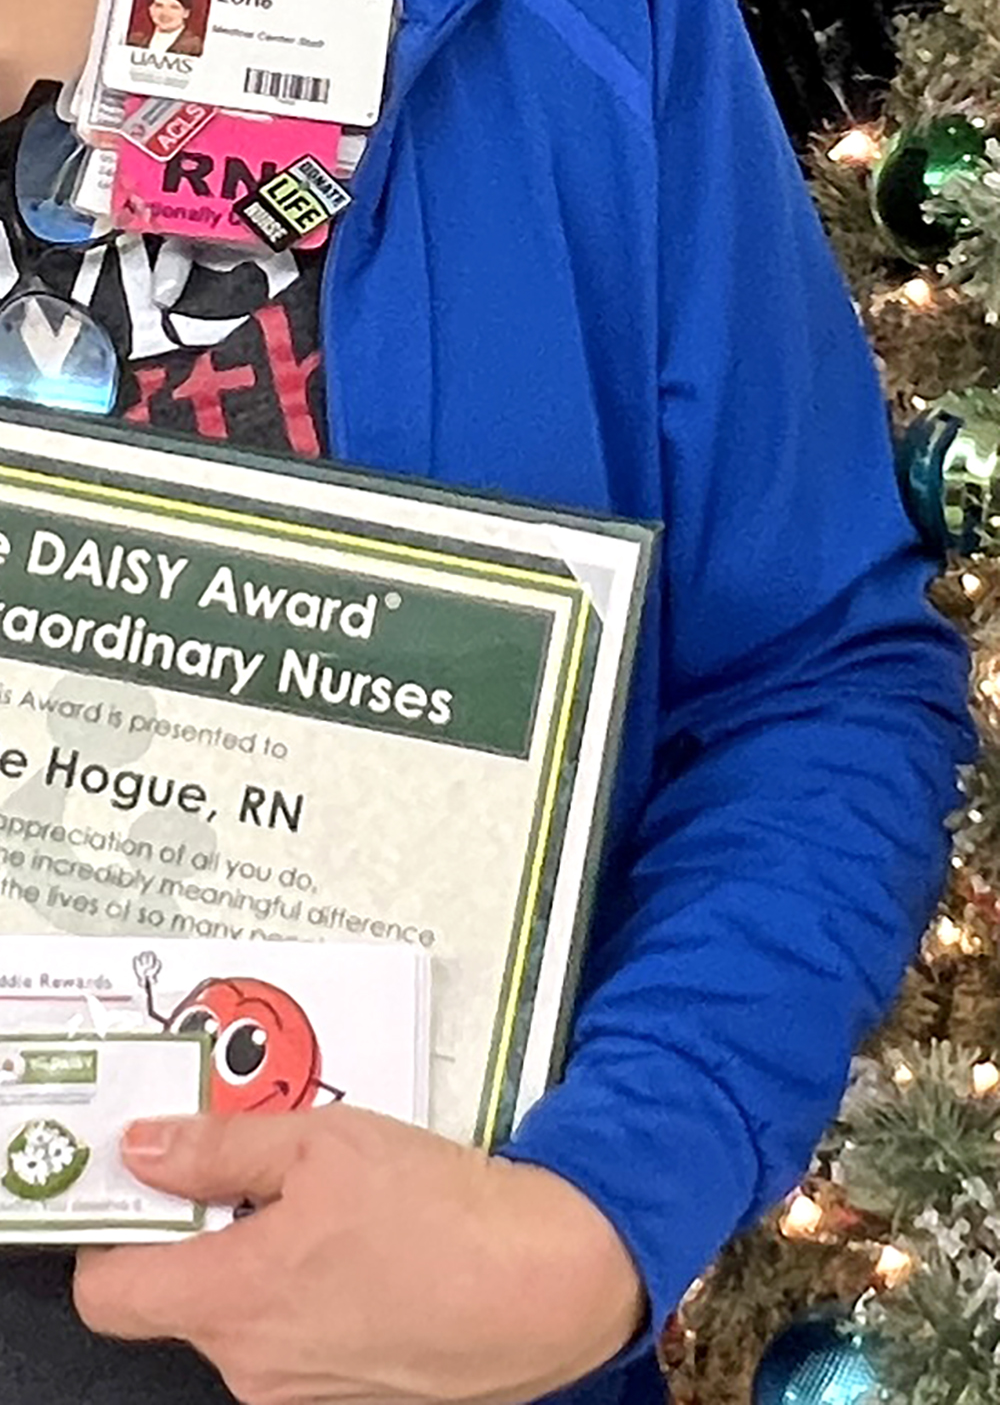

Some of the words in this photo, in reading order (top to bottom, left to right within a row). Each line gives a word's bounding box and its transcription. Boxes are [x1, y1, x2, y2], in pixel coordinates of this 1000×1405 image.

[130, 51, 194, 74] UAMS
[157, 103, 206, 152] ACLS
[162, 151, 278, 200] RN
[266, 177, 322, 230] LIFE
[26, 530, 188, 600] DAISY
[278, 648, 454, 726] Nurses
[18, 689, 101, 724] Award
[109, 703, 122, 728] is
[128, 713, 257, 753] presented
[264, 736, 289, 759] to
[45, 746, 217, 824] Hogue,
[238, 783, 305, 833] RN
[159, 843, 187, 865] of
[191, 850, 220, 872] all
[225, 859, 272, 882] you
[0, 878, 41, 904] the
[46, 882, 99, 917] lives
[105, 899, 131, 921] of
[138, 906, 164, 927] so
[171, 912, 245, 940] many
[31, 850, 154, 894] incredibly
[159, 876, 303, 921] meaningful
[307, 903, 437, 948] difference
[40, 973, 113, 990] Rewards
